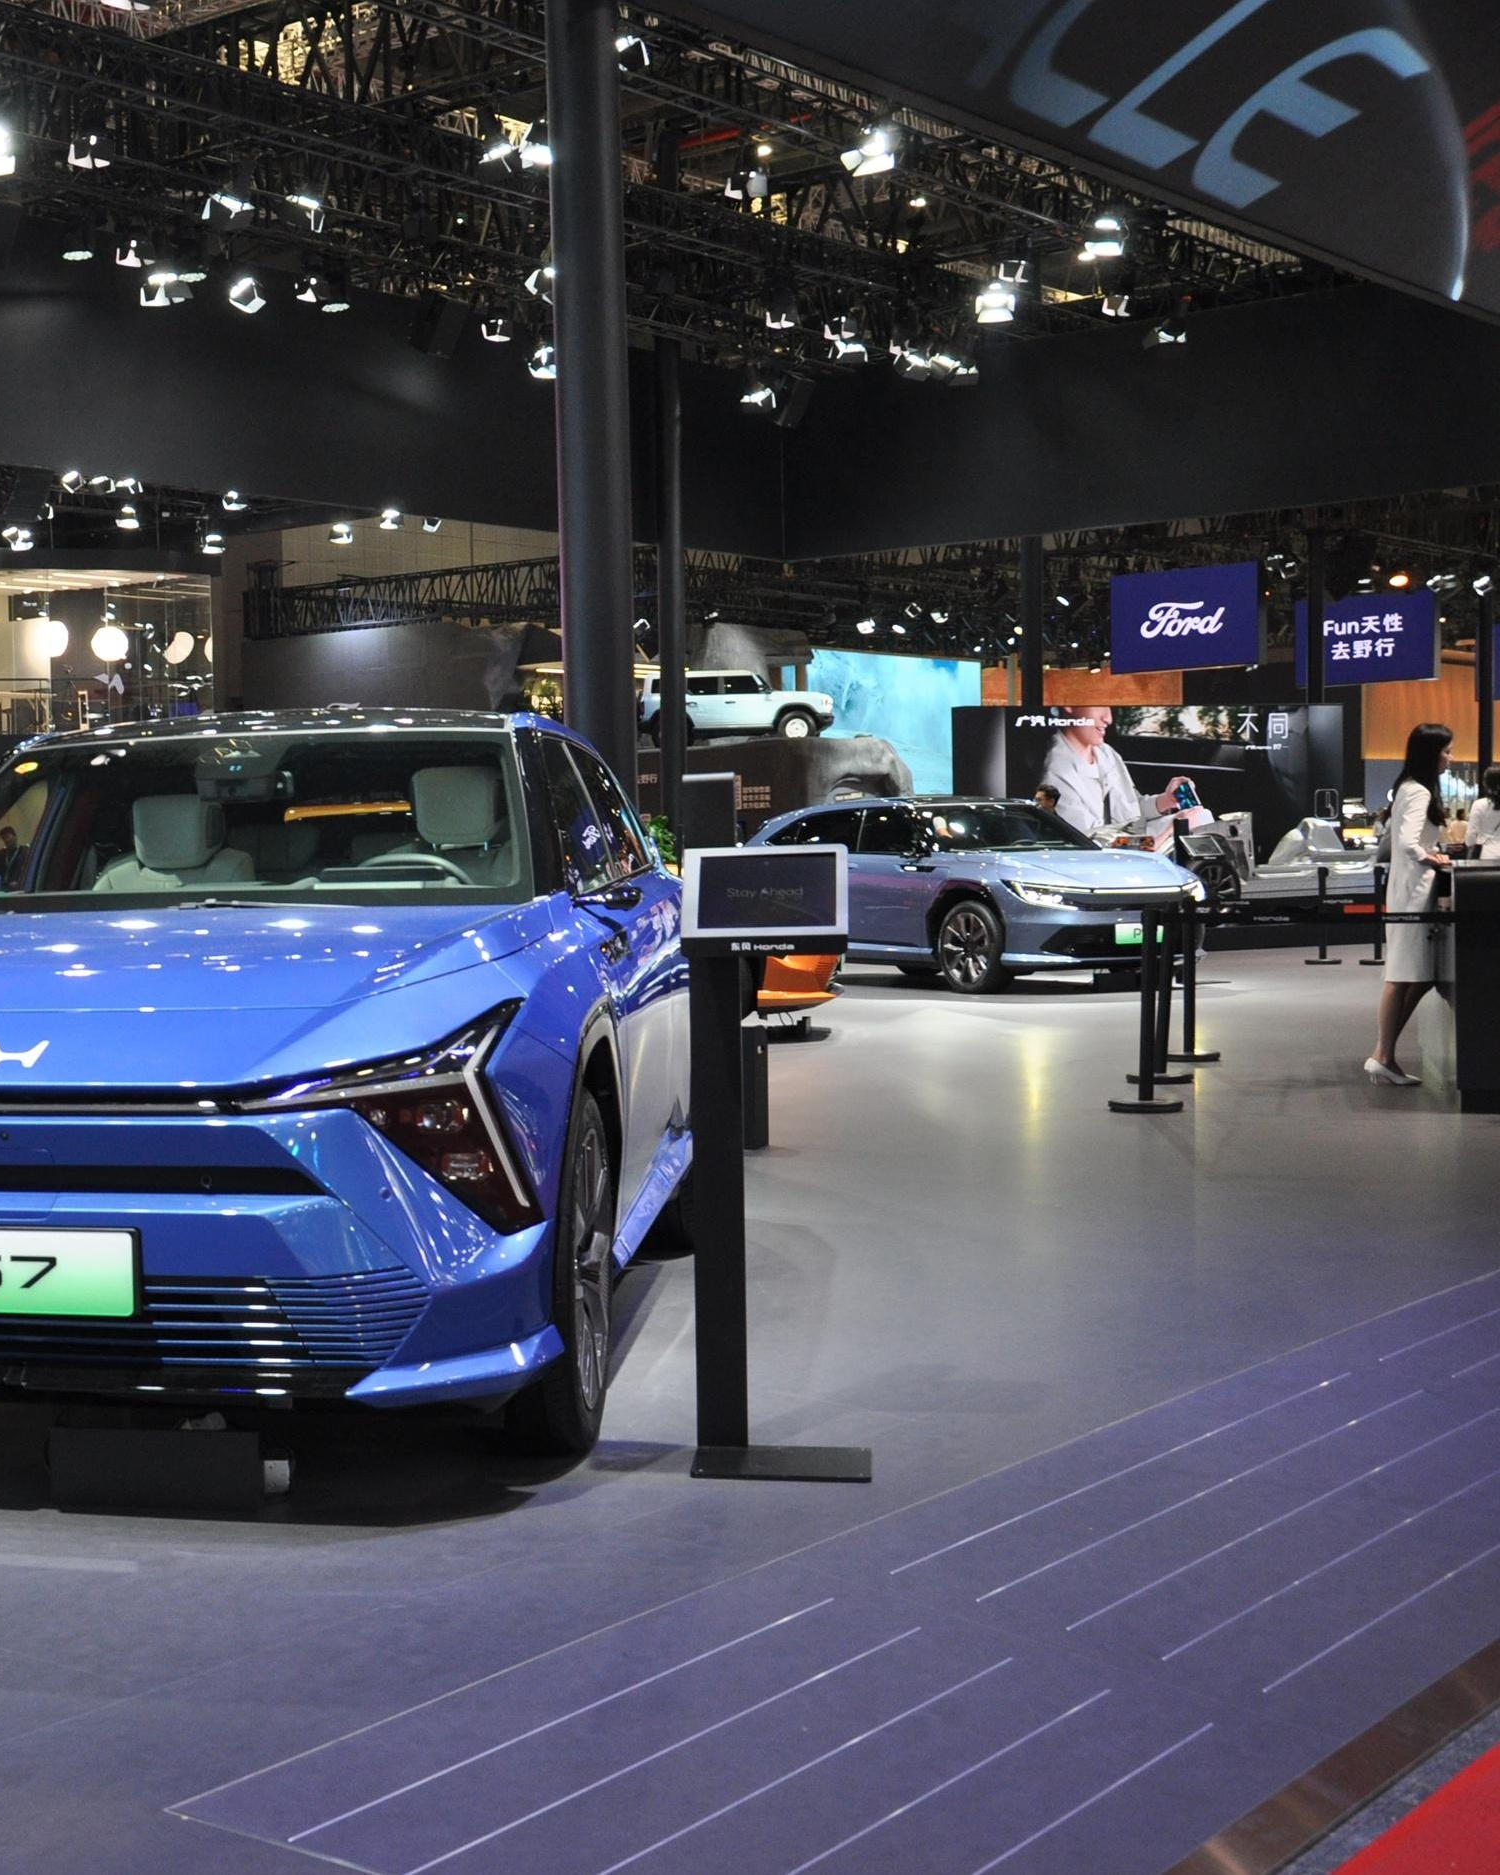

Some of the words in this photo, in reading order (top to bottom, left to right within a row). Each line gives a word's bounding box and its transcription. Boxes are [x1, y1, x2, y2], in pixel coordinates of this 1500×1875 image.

[1140, 601, 1226, 639] Ford
[1323, 613, 1404, 637] Fun天性
[1330, 637, 1396, 660] 去野行
[1048, 717, 1096, 726] Honda
[1237, 712, 1289, 740] 不同
[726, 887, 756, 898] Stay
[760, 887, 804, 897] Ahead
